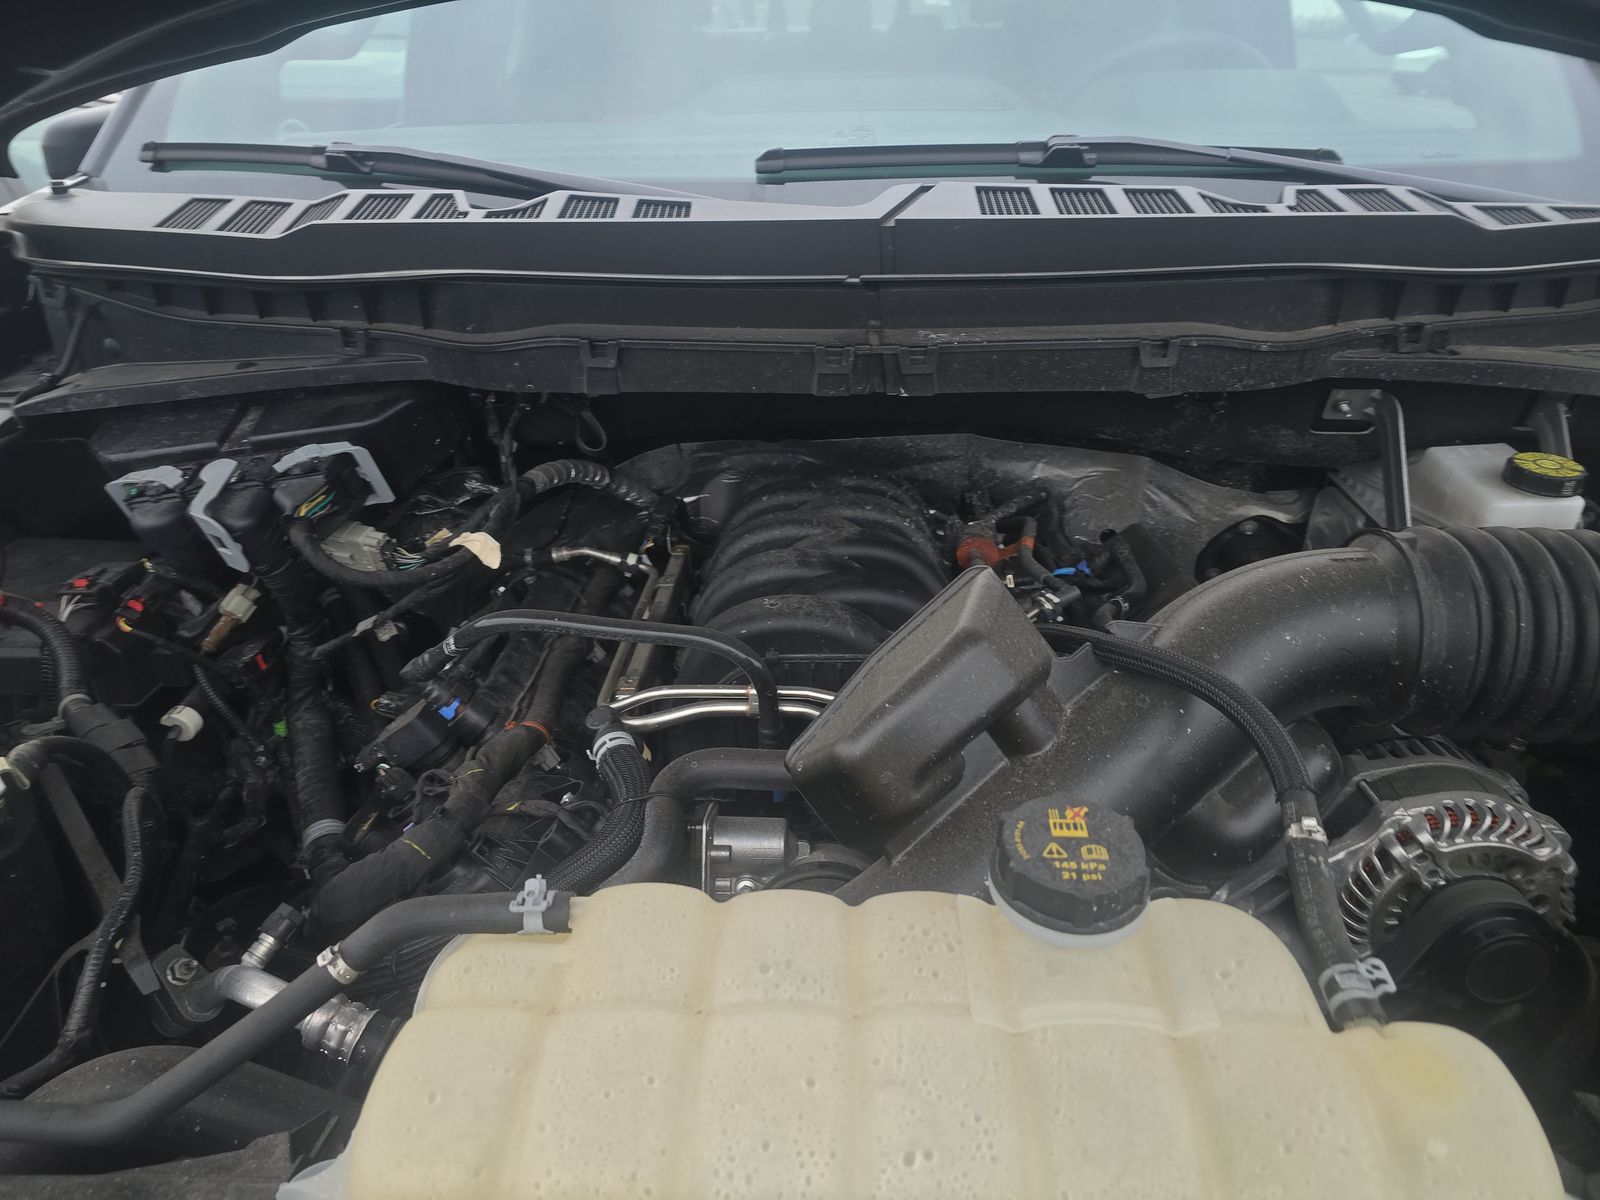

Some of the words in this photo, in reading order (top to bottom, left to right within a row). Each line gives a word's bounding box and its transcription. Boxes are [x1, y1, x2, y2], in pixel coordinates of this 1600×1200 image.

[1080, 861, 1106, 871] kPa
[1061, 870, 1077, 880] 21
[1082, 872, 1102, 881] psi
